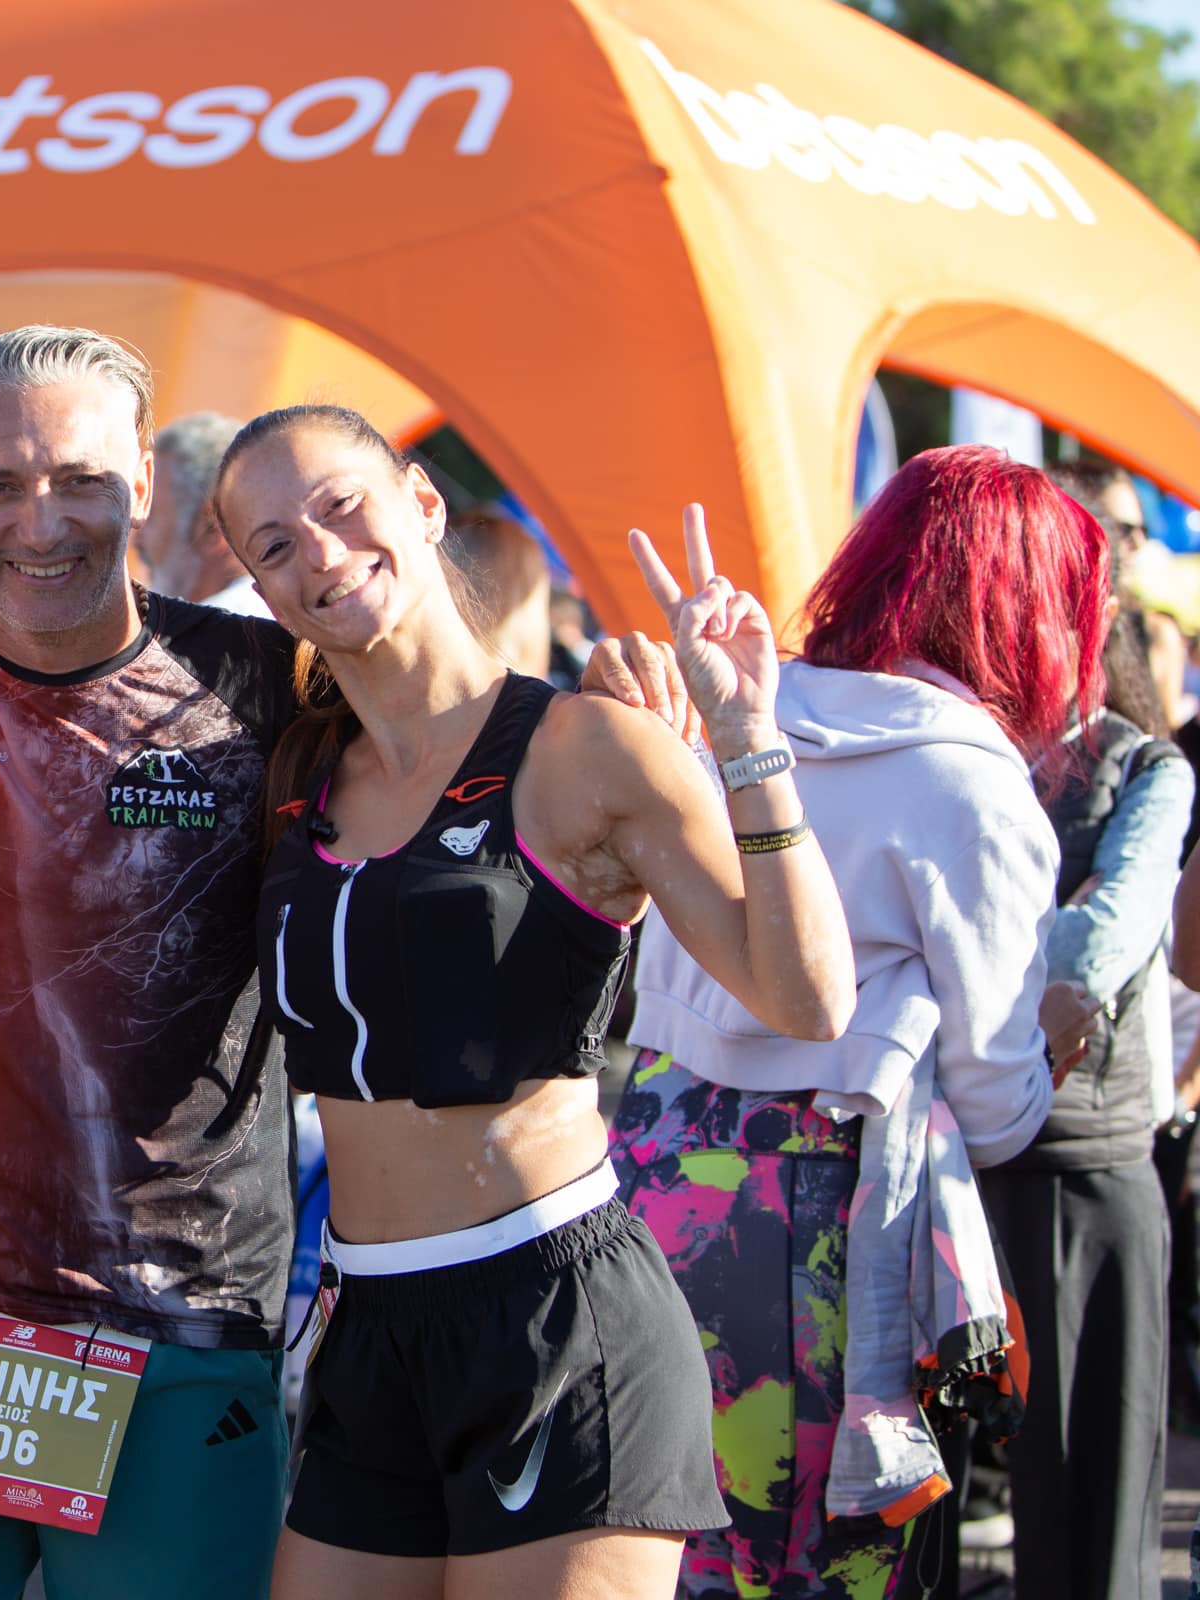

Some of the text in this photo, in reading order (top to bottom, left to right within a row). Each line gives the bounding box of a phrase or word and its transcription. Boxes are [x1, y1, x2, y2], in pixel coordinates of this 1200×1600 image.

[110, 806, 216, 829] TRAIL RUN
[89, 1342, 131, 1363] TERNA
